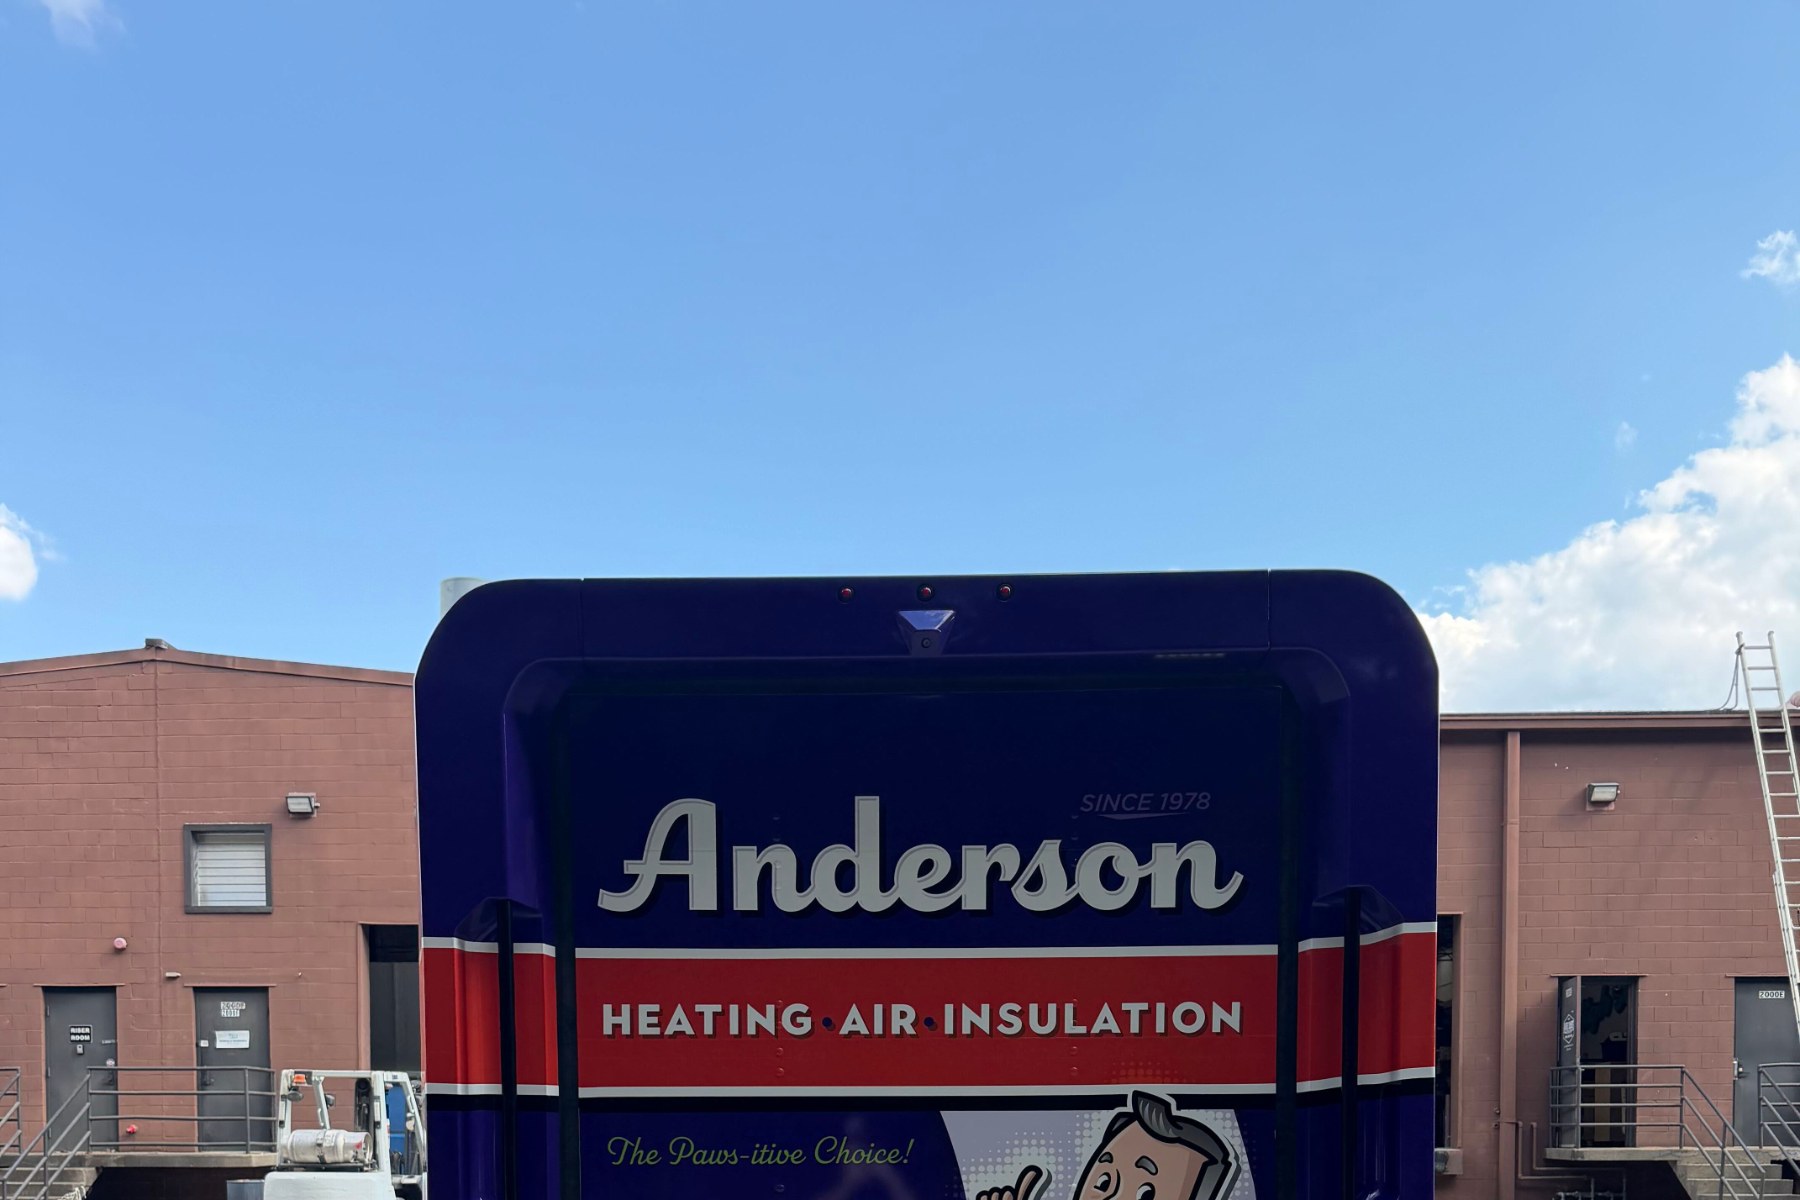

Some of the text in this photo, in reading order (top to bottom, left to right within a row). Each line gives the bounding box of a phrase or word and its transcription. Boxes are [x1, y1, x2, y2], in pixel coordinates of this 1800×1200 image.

[1080, 792, 1211, 812] SINCE 1978
[597, 795, 1244, 913] Anderson
[602, 1001, 1241, 1036] HEATING AIR INSULATION
[607, 1136, 915, 1166] The Paws-itive Choice!
